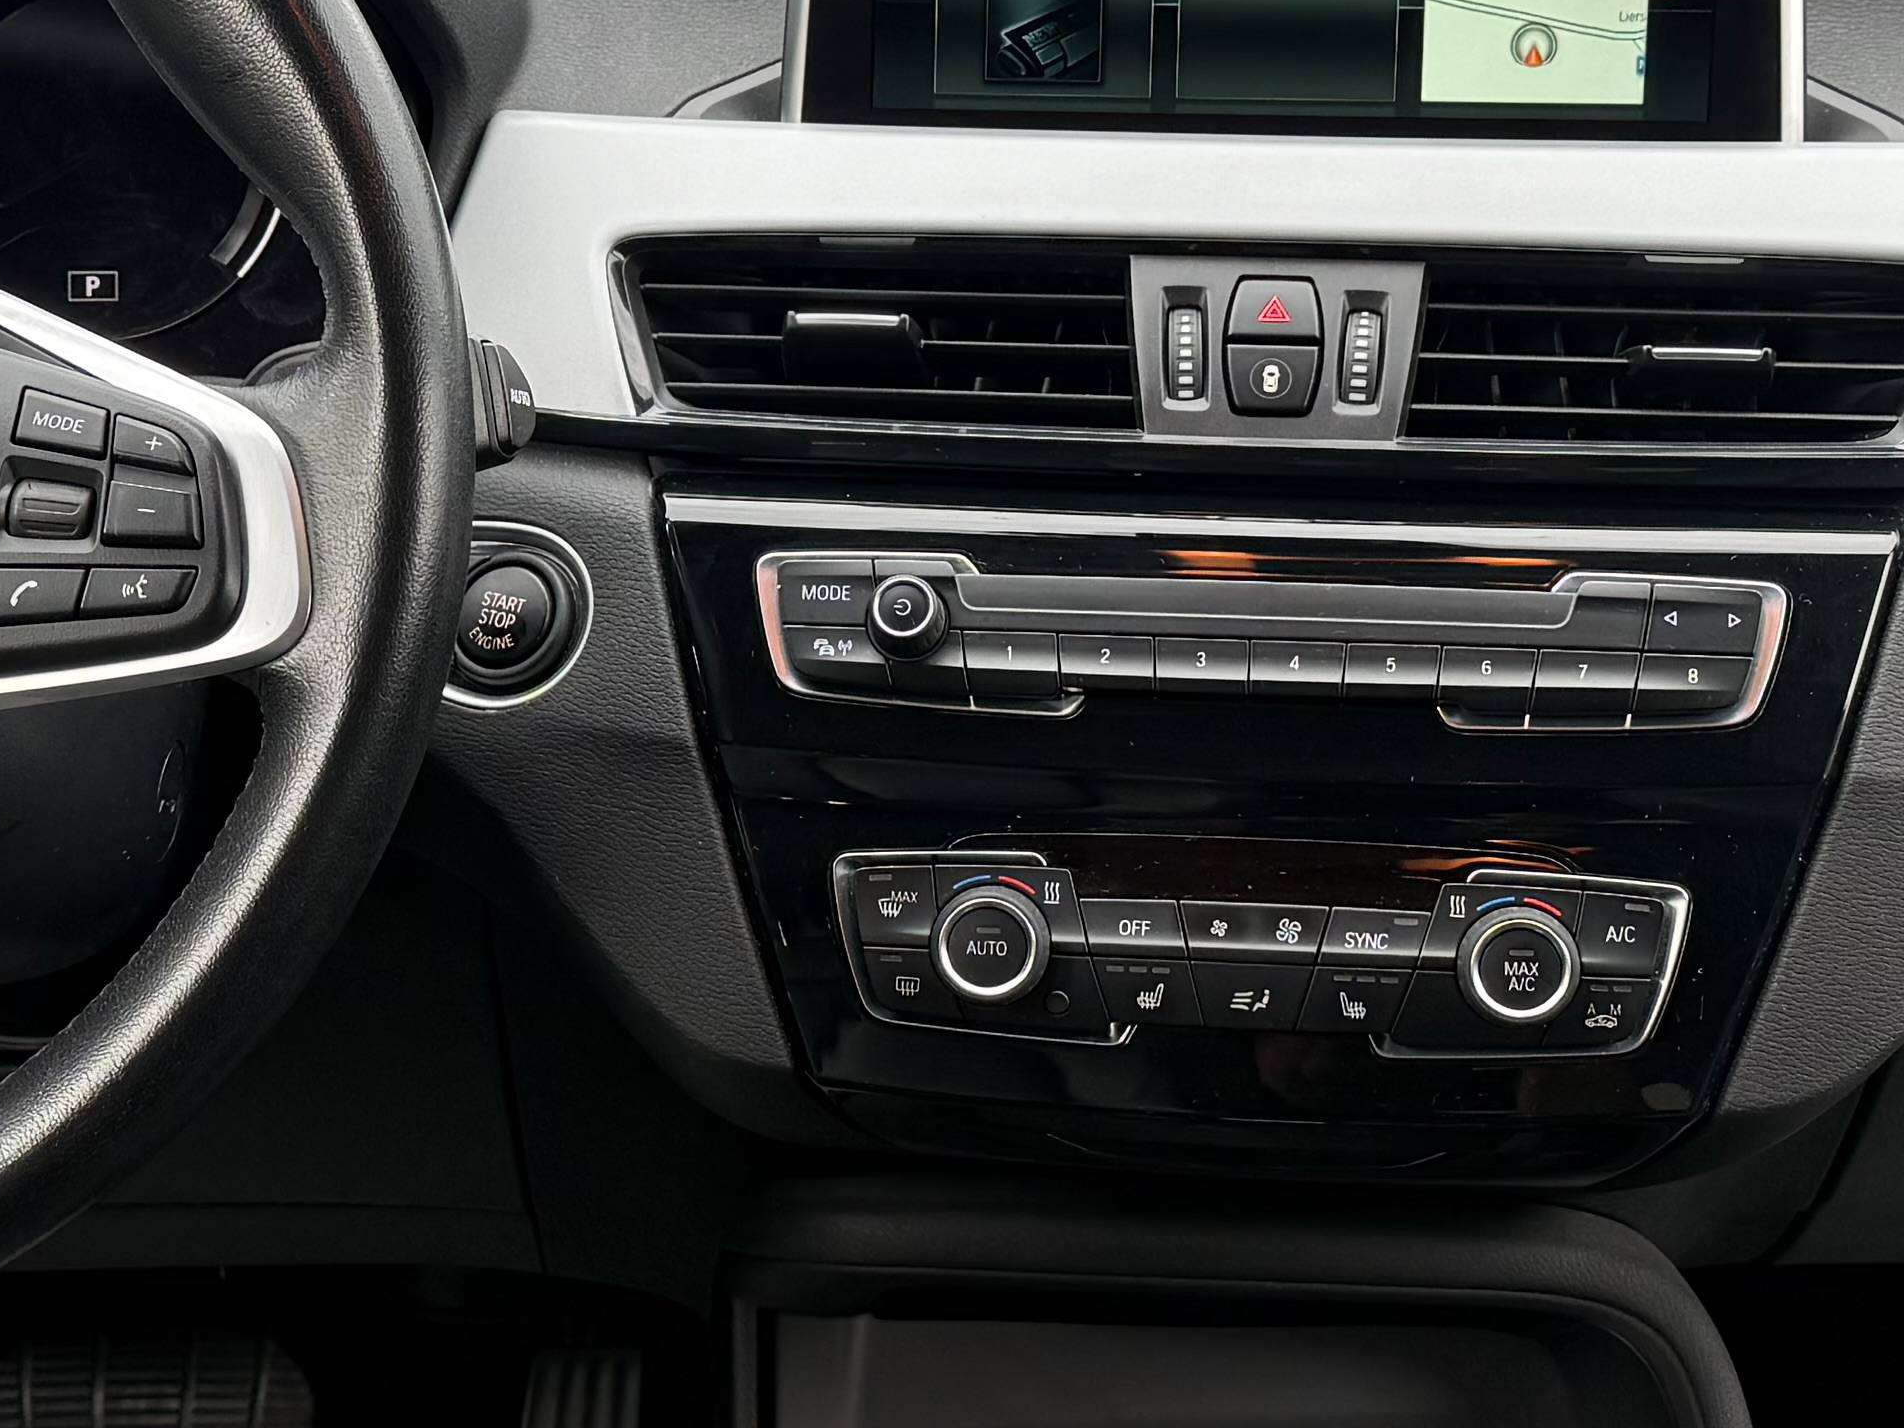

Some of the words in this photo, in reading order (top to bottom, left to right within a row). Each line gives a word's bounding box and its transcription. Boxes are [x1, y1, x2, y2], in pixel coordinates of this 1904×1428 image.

[84, 275, 100, 297] P
[31, 409, 86, 435] MODE
[801, 584, 851, 602] MODE
[481, 590, 527, 614] START
[478, 607, 517, 629] STOP
[468, 626, 516, 650] ENGINE
[1007, 645, 1014, 661] 1
[1099, 648, 1111, 664] 2
[1195, 651, 1206, 667] 3
[1289, 655, 1300, 670] 4
[1385, 657, 1397, 673] 5
[1480, 659, 1492, 676] 6
[1577, 664, 1589, 680] 7
[1687, 668, 1700, 685] 8
[891, 890, 919, 905] MAX
[1118, 919, 1151, 937] OFF
[1605, 925, 1636, 943] A/C
[965, 939, 1008, 958] AUTO
[1344, 932, 1389, 951] SYNC
[1504, 960, 1539, 977] MAX
[1507, 975, 1536, 992] A/C
